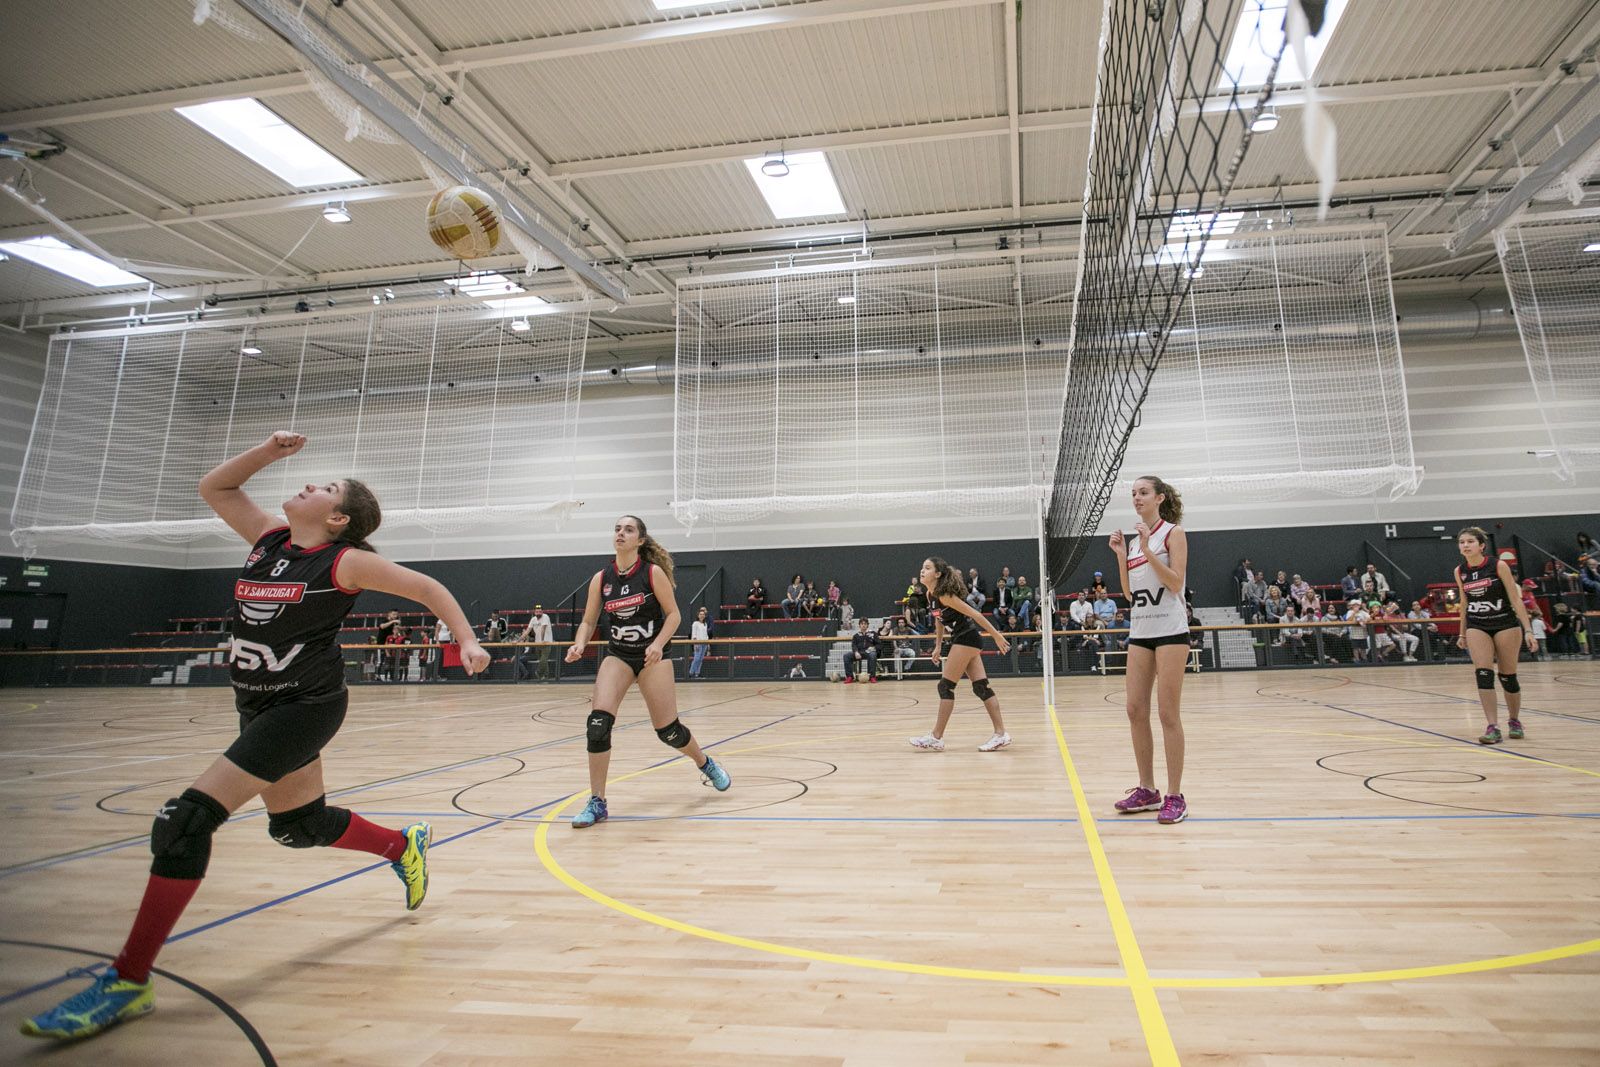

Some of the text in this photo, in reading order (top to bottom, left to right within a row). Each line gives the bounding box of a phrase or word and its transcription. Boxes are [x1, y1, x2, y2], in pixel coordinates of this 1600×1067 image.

[1385, 524, 1397, 537] H
[270, 558, 290, 577] 8
[620, 584, 630, 596] 13
[610, 620, 654, 642] DSV
